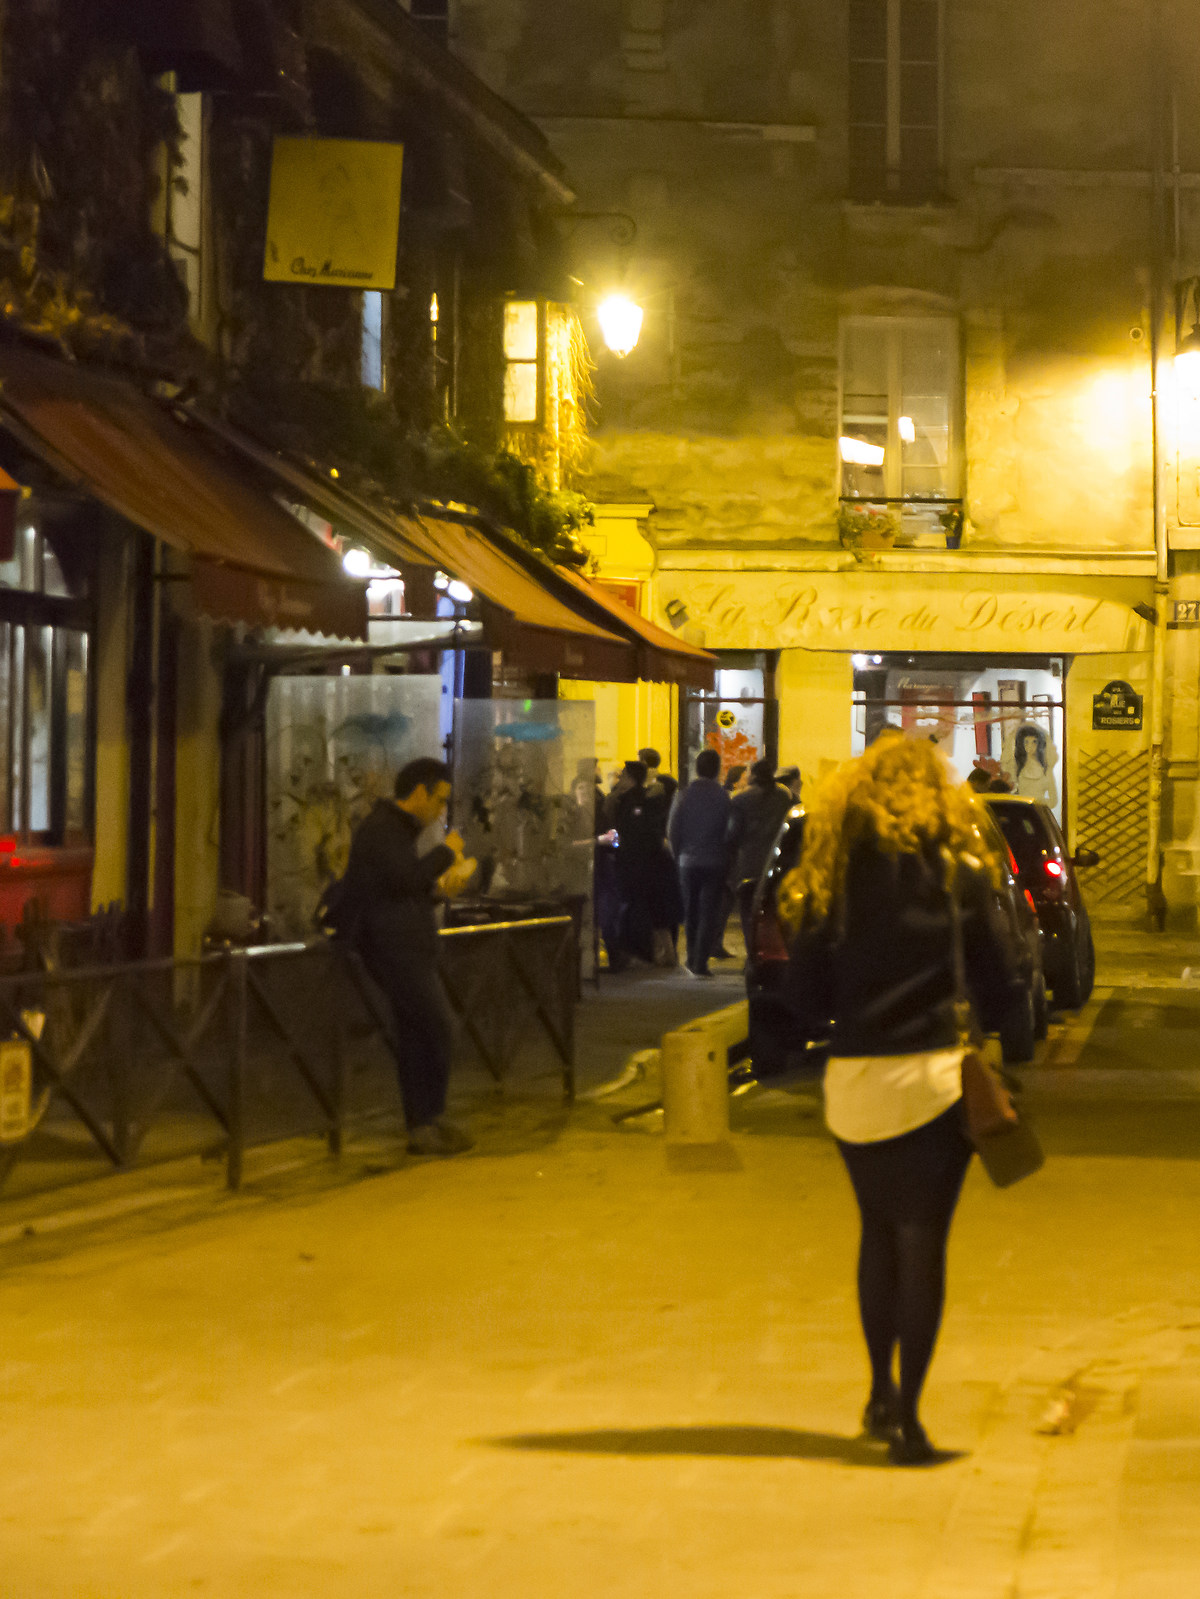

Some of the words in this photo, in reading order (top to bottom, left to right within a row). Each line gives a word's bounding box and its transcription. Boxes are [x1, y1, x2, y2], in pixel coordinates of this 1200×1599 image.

[898, 605, 940, 629] du
[1177, 602, 1198, 621] 27
[1100, 716, 1135, 725] ROSIERS
